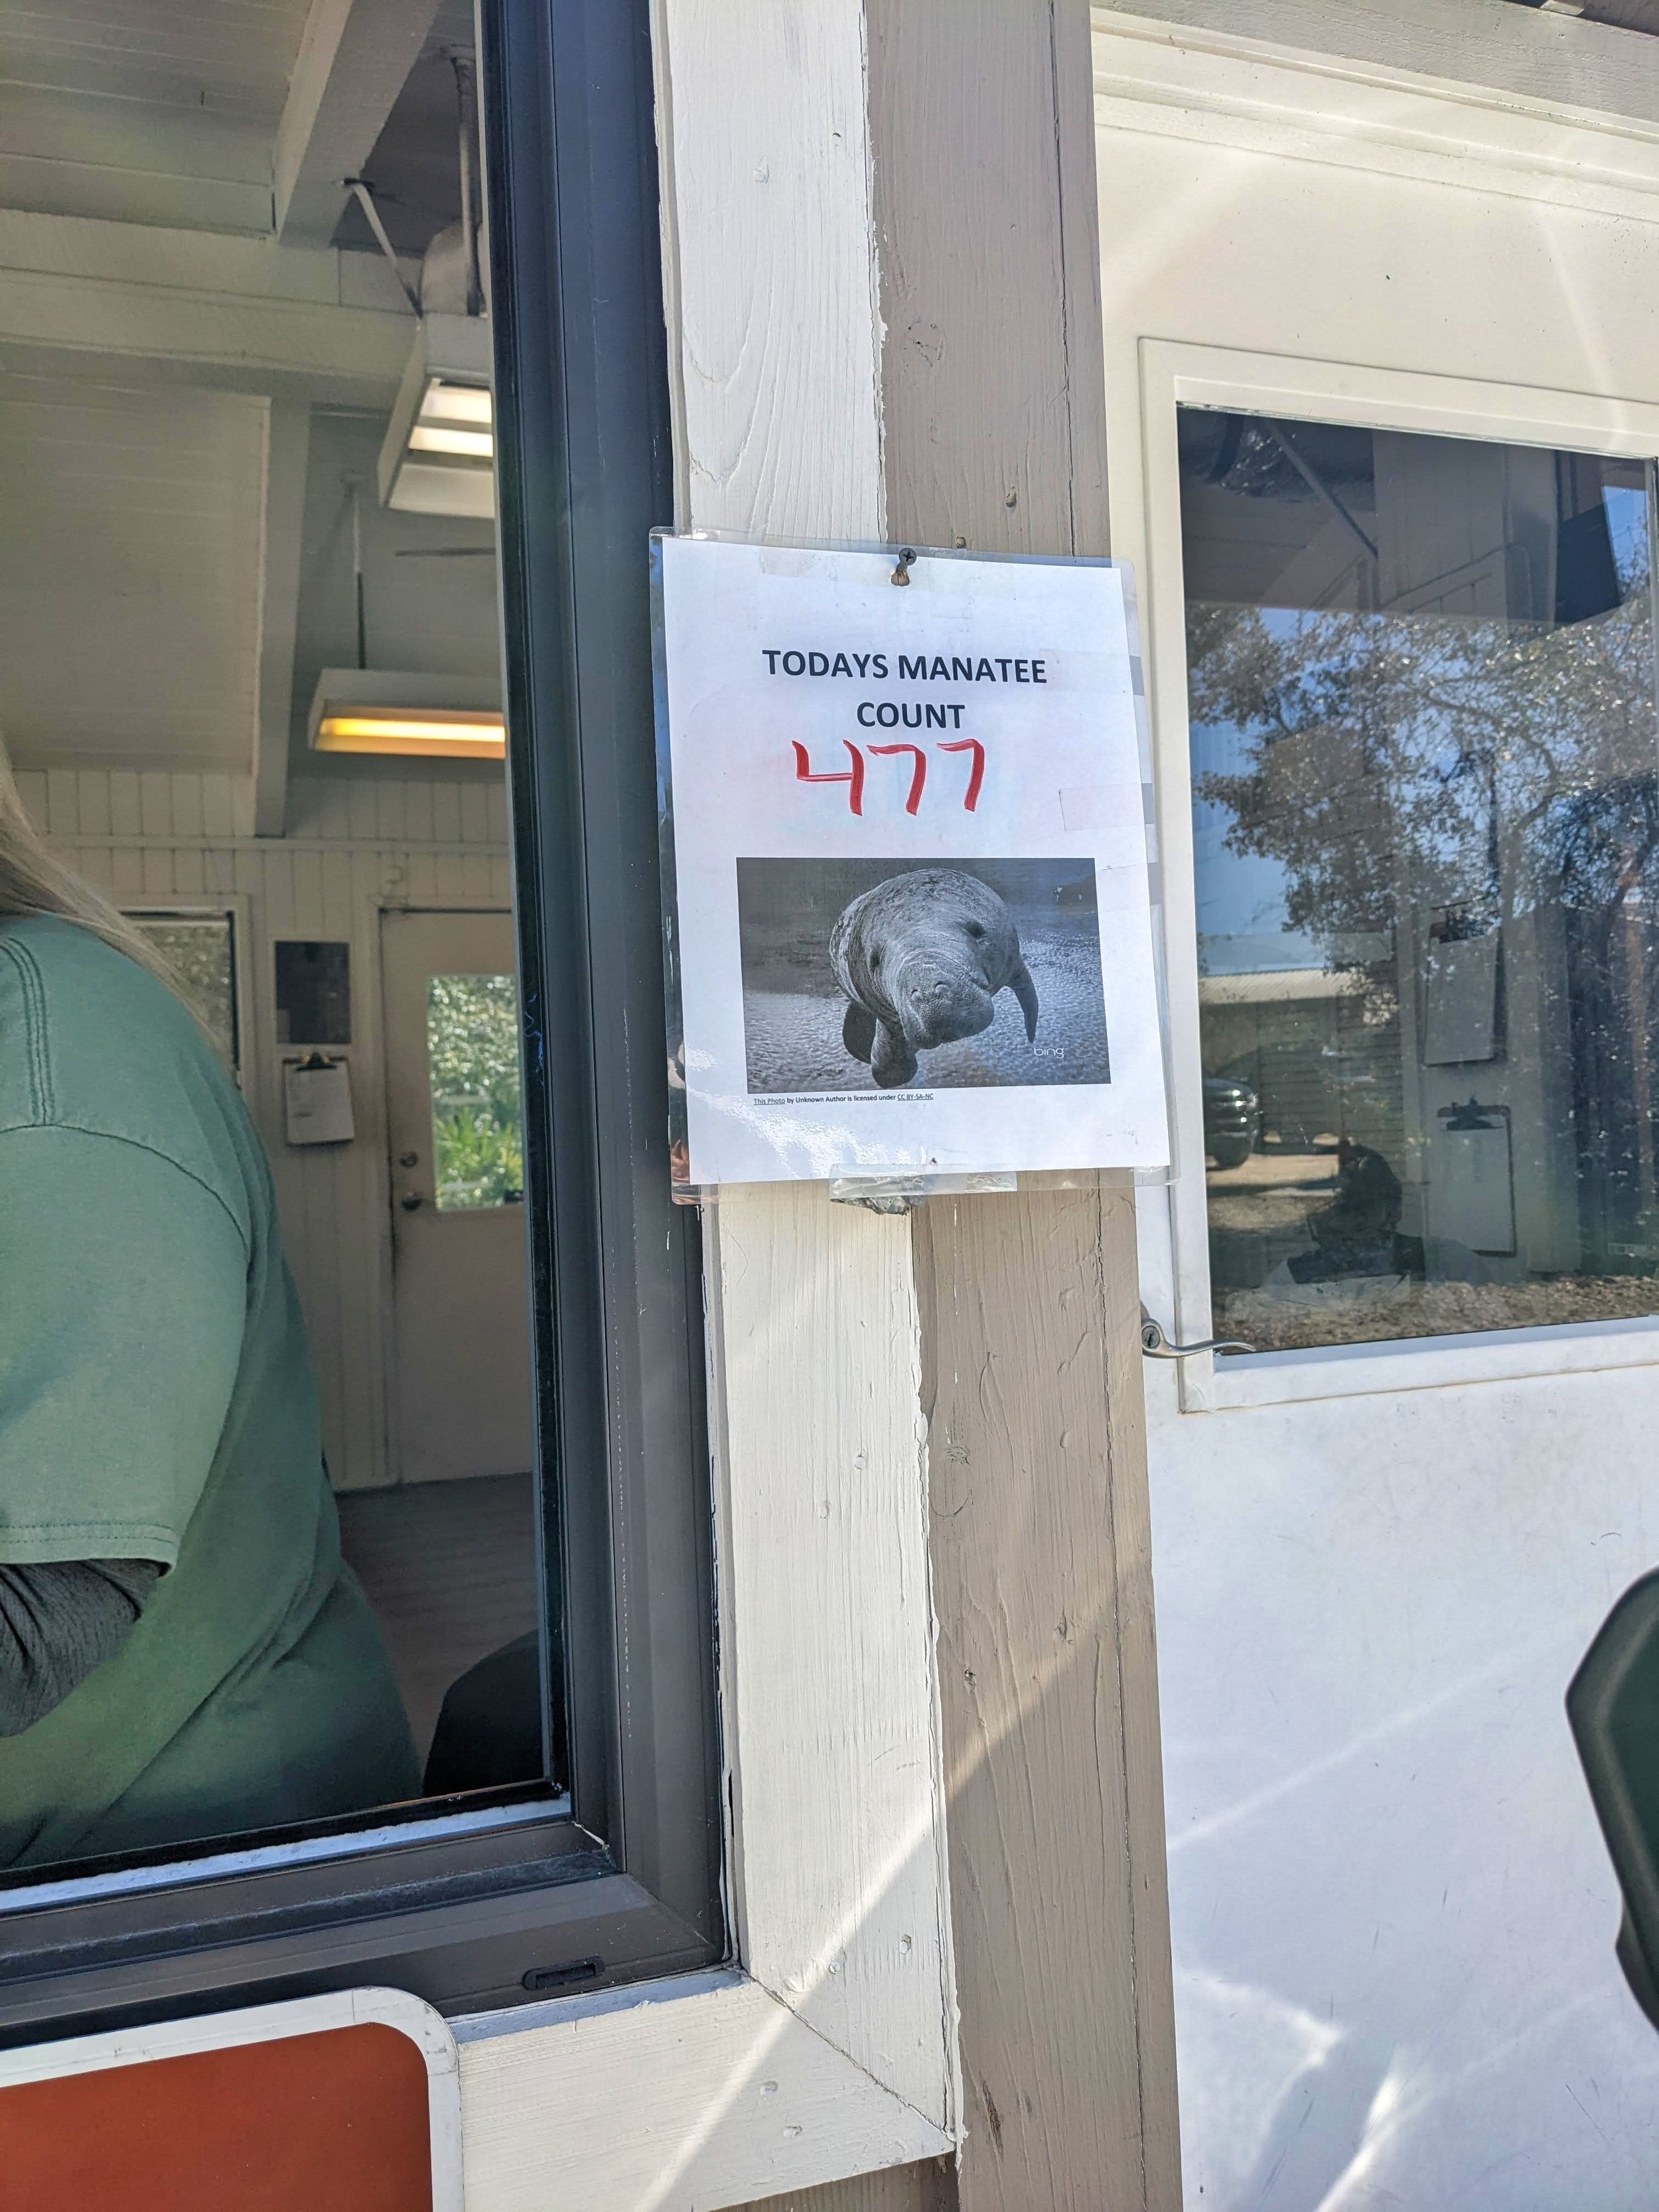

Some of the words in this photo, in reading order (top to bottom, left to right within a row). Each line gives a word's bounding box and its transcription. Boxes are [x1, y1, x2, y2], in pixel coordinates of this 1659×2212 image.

[762, 650, 889, 679] TODAYS
[898, 655, 1047, 684] MANATEE
[857, 701, 966, 729] COUNT
[792, 739, 984, 816] 477
[1033, 1047, 1064, 1059] bing
